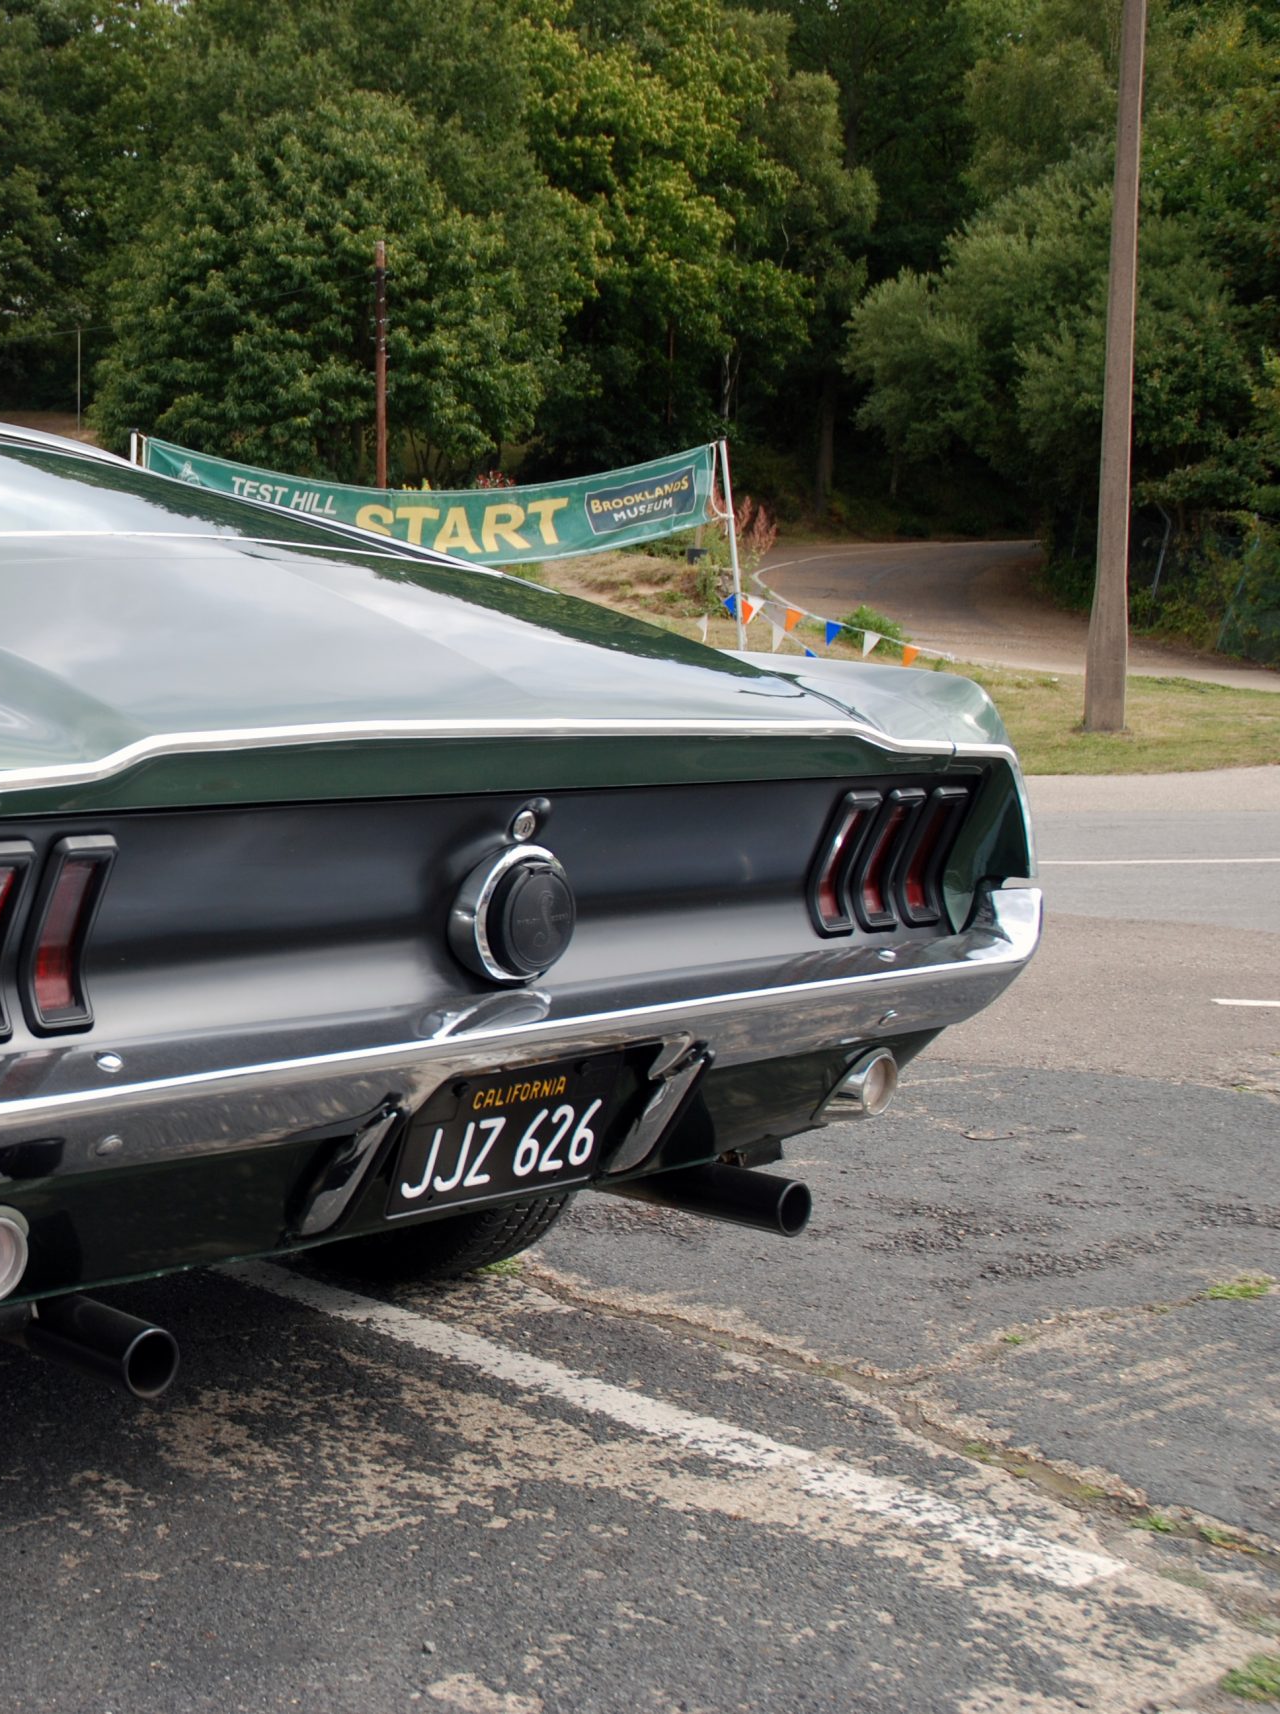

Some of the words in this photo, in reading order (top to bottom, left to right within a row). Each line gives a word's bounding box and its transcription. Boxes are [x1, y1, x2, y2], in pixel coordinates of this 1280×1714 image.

[232, 476, 289, 505] TEST
[290, 490, 337, 515] HILL
[590, 475, 689, 514] BROOKLANDS
[613, 497, 673, 522] MUSEUM
[355, 497, 569, 555] START
[472, 1076, 567, 1110] CALIFORNIA
[400, 1116, 506, 1199] JJZ
[512, 1098, 603, 1177] 626
